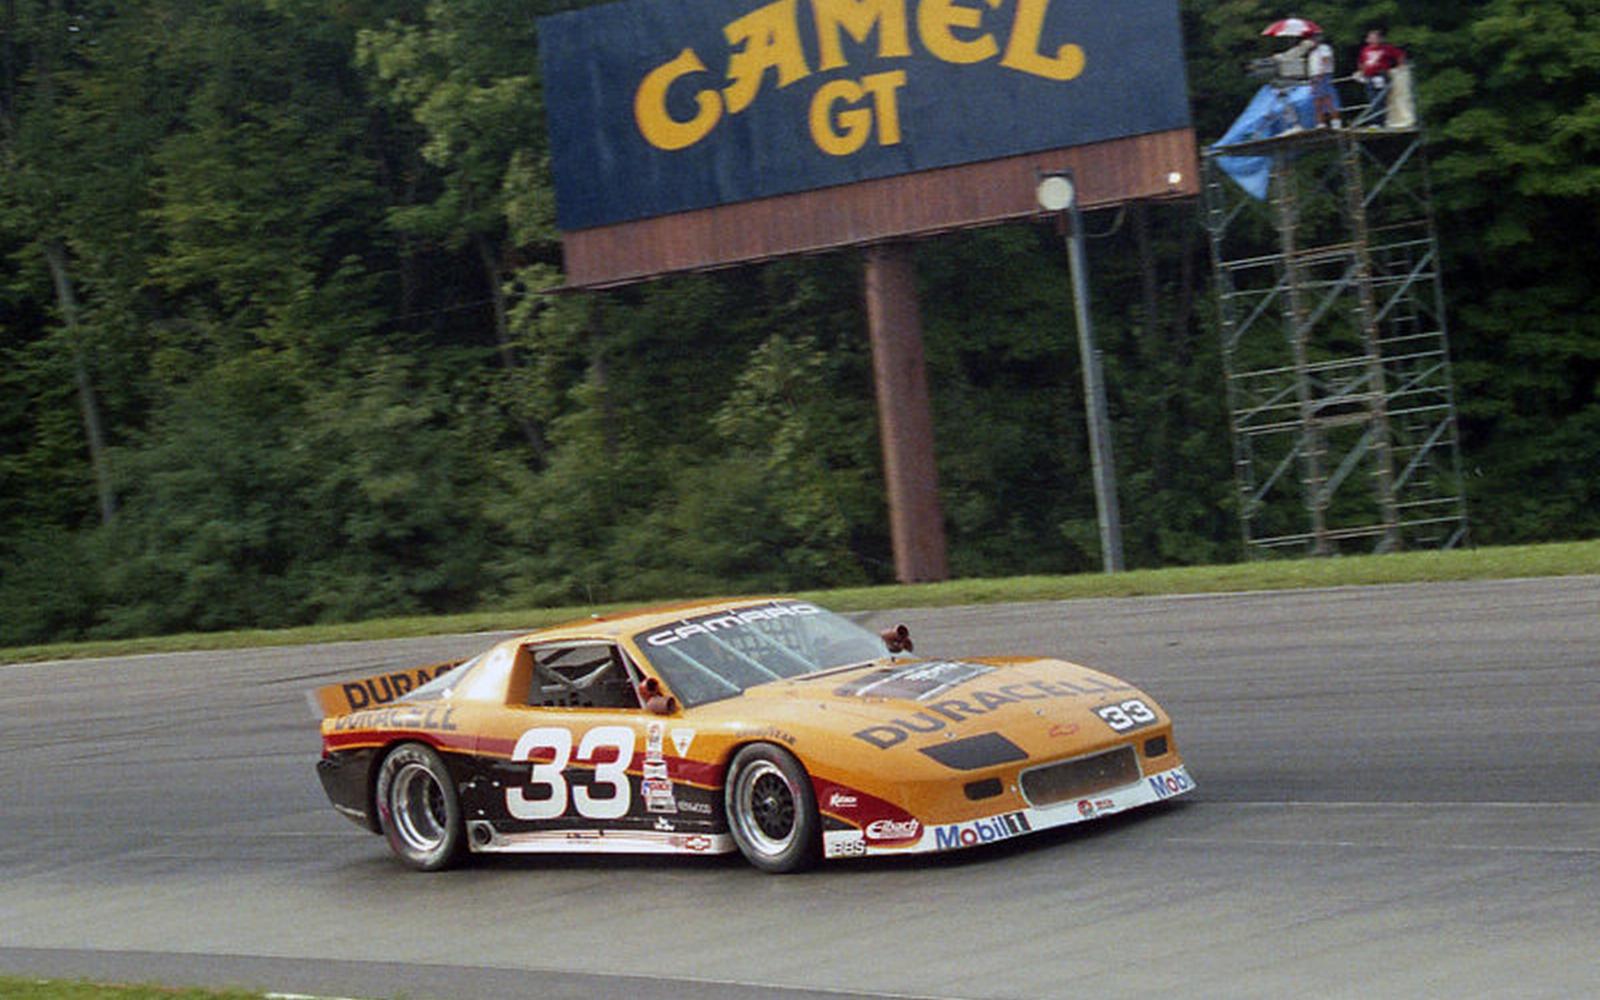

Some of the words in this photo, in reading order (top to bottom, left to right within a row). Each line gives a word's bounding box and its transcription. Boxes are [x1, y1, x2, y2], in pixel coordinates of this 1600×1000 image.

[633, 0, 1086, 151] CAMEL
[809, 71, 906, 156] GT
[852, 676, 1138, 751] DURACELL
[1097, 699, 1157, 733] 33
[506, 727, 635, 820] 33
